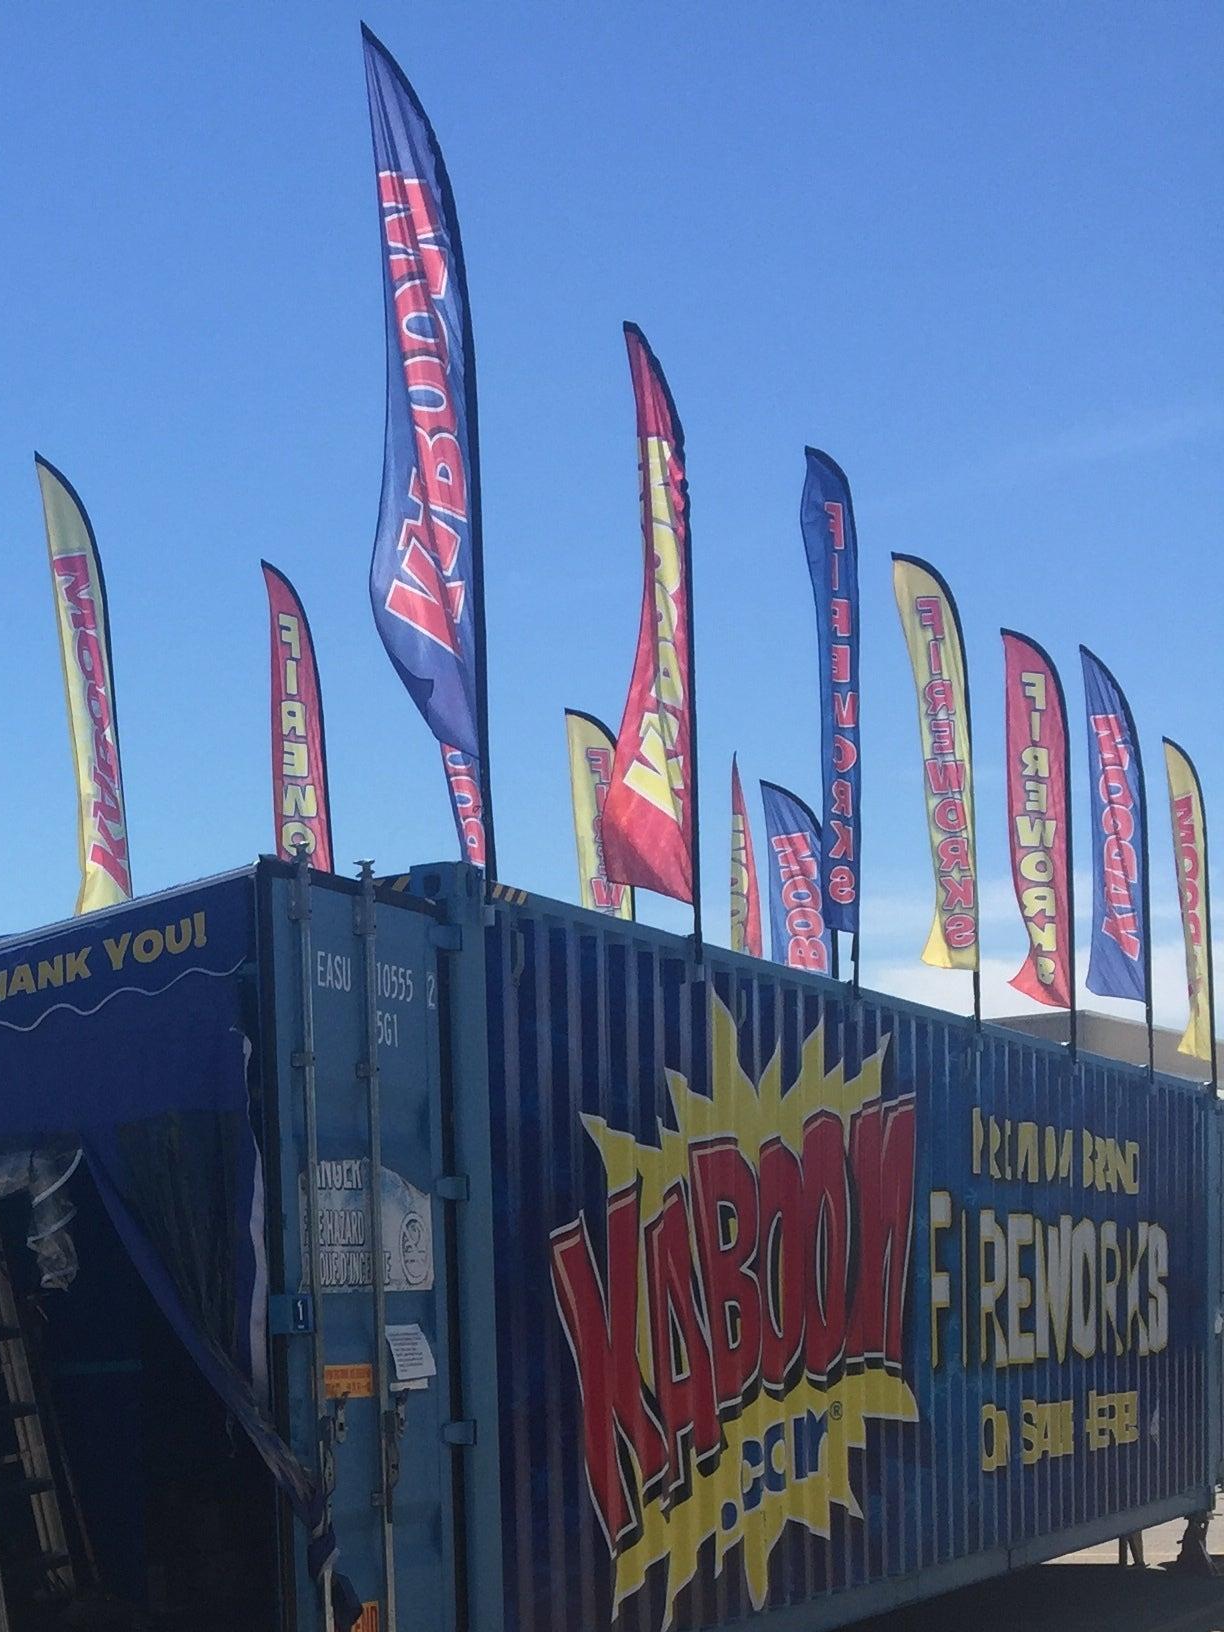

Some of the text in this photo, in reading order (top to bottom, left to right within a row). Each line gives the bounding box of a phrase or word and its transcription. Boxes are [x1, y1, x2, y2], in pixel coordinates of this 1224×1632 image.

[102, 911, 209, 973] YOU!
[317, 951, 436, 1008] EASU 10555 2
[376, 1009, 399, 1048] 5G1
[929, 1190, 1169, 1369] FIREWORKS
[550, 1093, 918, 1560] KABOOM
